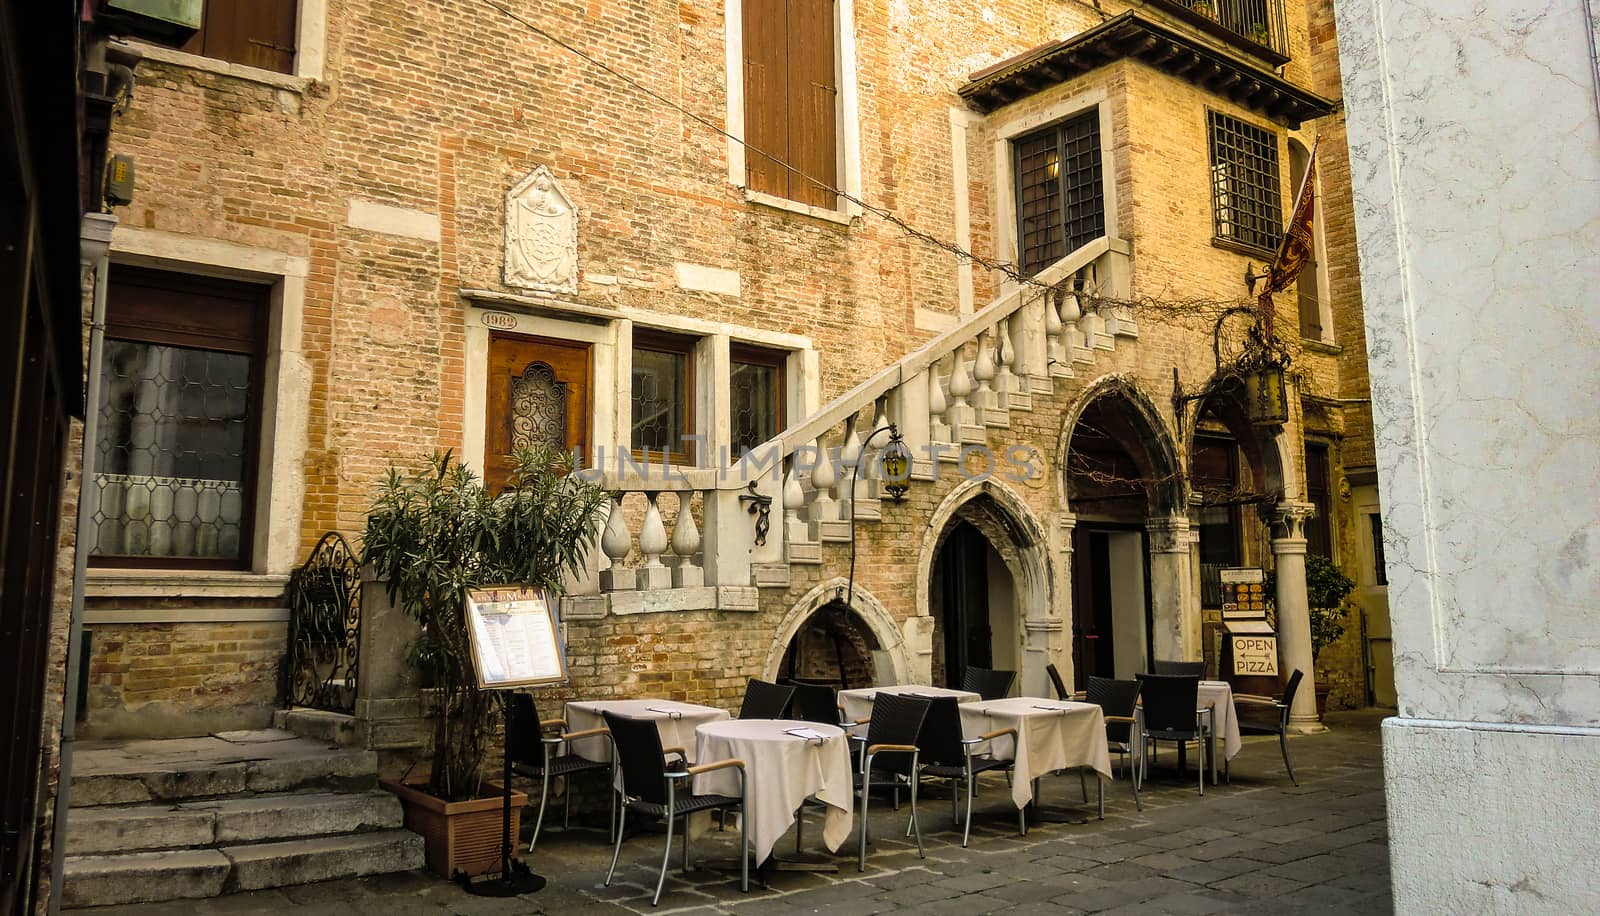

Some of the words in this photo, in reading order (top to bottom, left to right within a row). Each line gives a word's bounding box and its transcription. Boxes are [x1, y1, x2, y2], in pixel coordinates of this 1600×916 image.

[486, 314, 514, 327] 1982
[1235, 639, 1273, 651] OPEN
[1236, 661, 1275, 673] PIZZA
